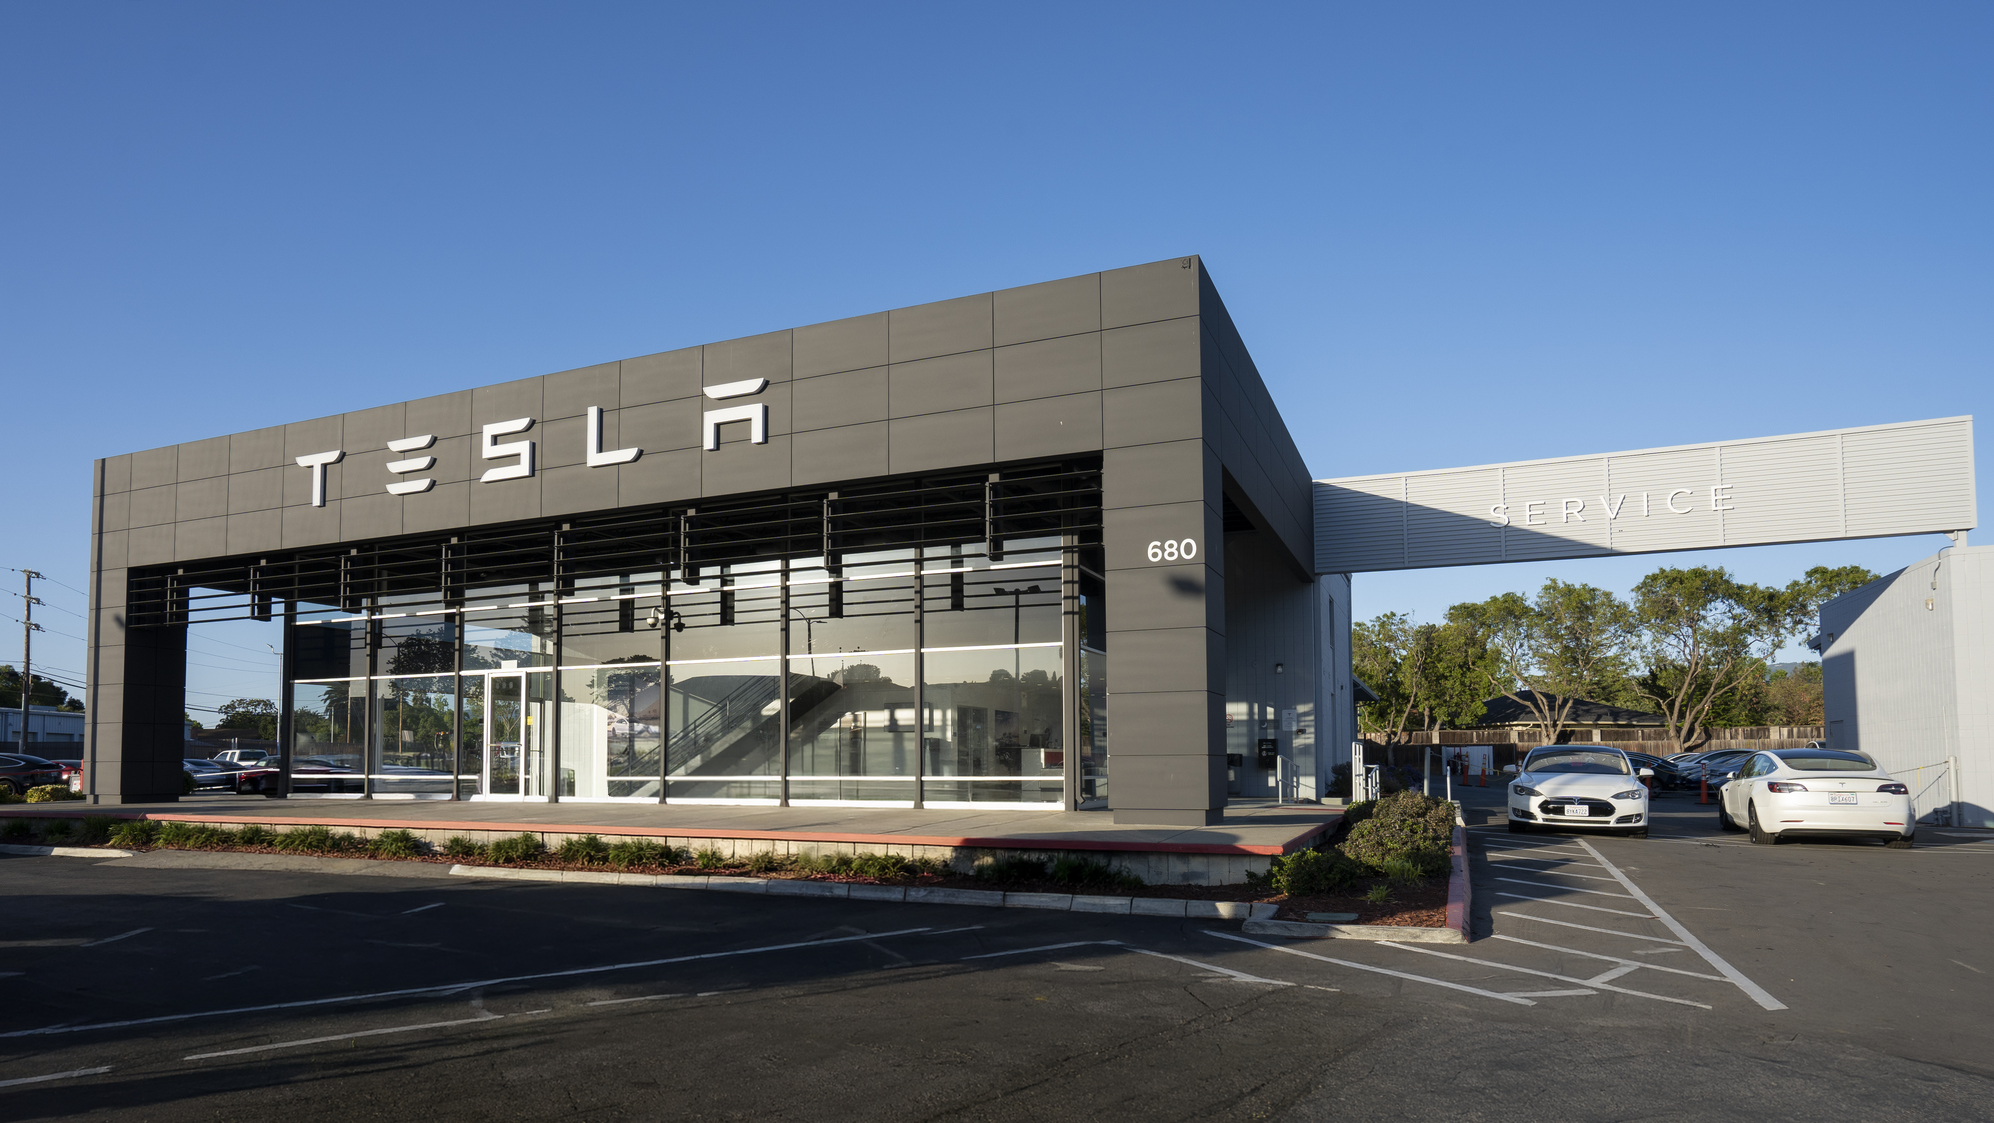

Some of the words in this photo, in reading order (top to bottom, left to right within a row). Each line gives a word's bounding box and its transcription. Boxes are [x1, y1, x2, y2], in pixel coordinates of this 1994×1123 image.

[295, 377, 768, 507] TESLA
[1489, 484, 1735, 528] SERVICE
[1147, 538, 1197, 562] 680
